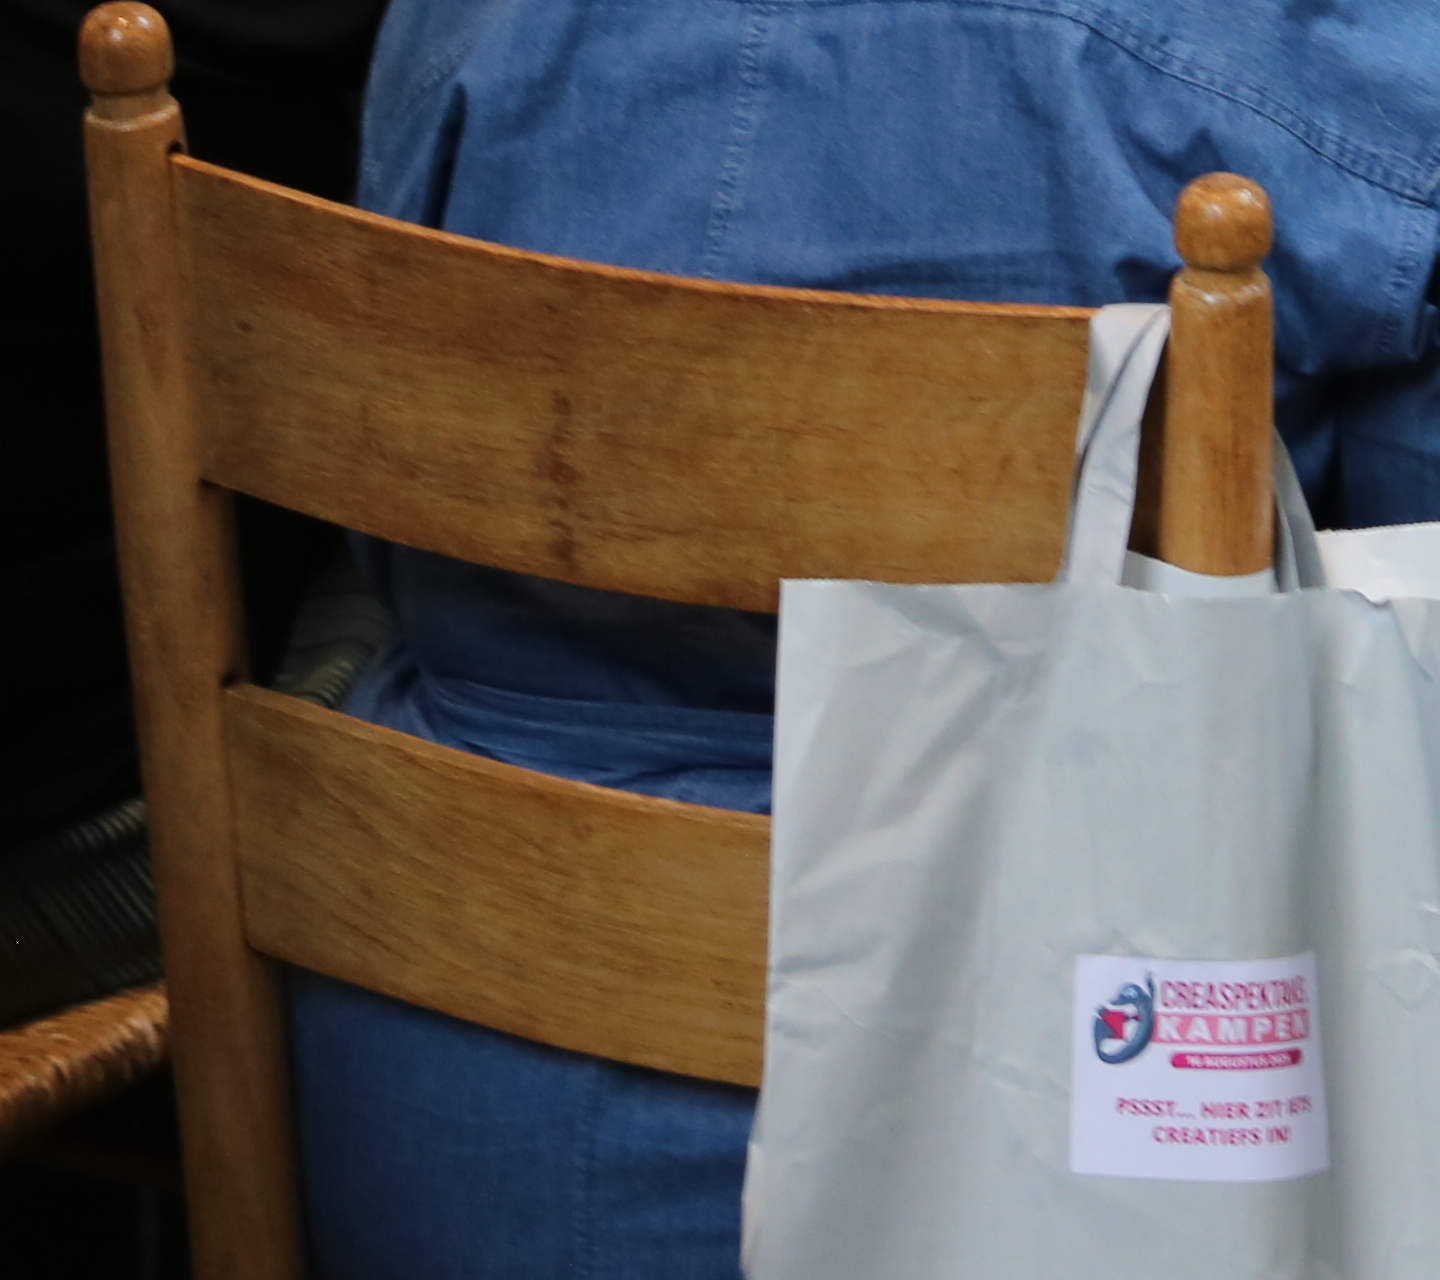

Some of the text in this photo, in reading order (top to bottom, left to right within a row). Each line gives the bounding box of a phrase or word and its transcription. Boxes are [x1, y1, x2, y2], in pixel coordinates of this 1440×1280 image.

[1160, 1011, 1307, 1043] KAMPEN
[1201, 1100, 1251, 1120] HIER
[1152, 1125, 1261, 1145] CREATIEFS
